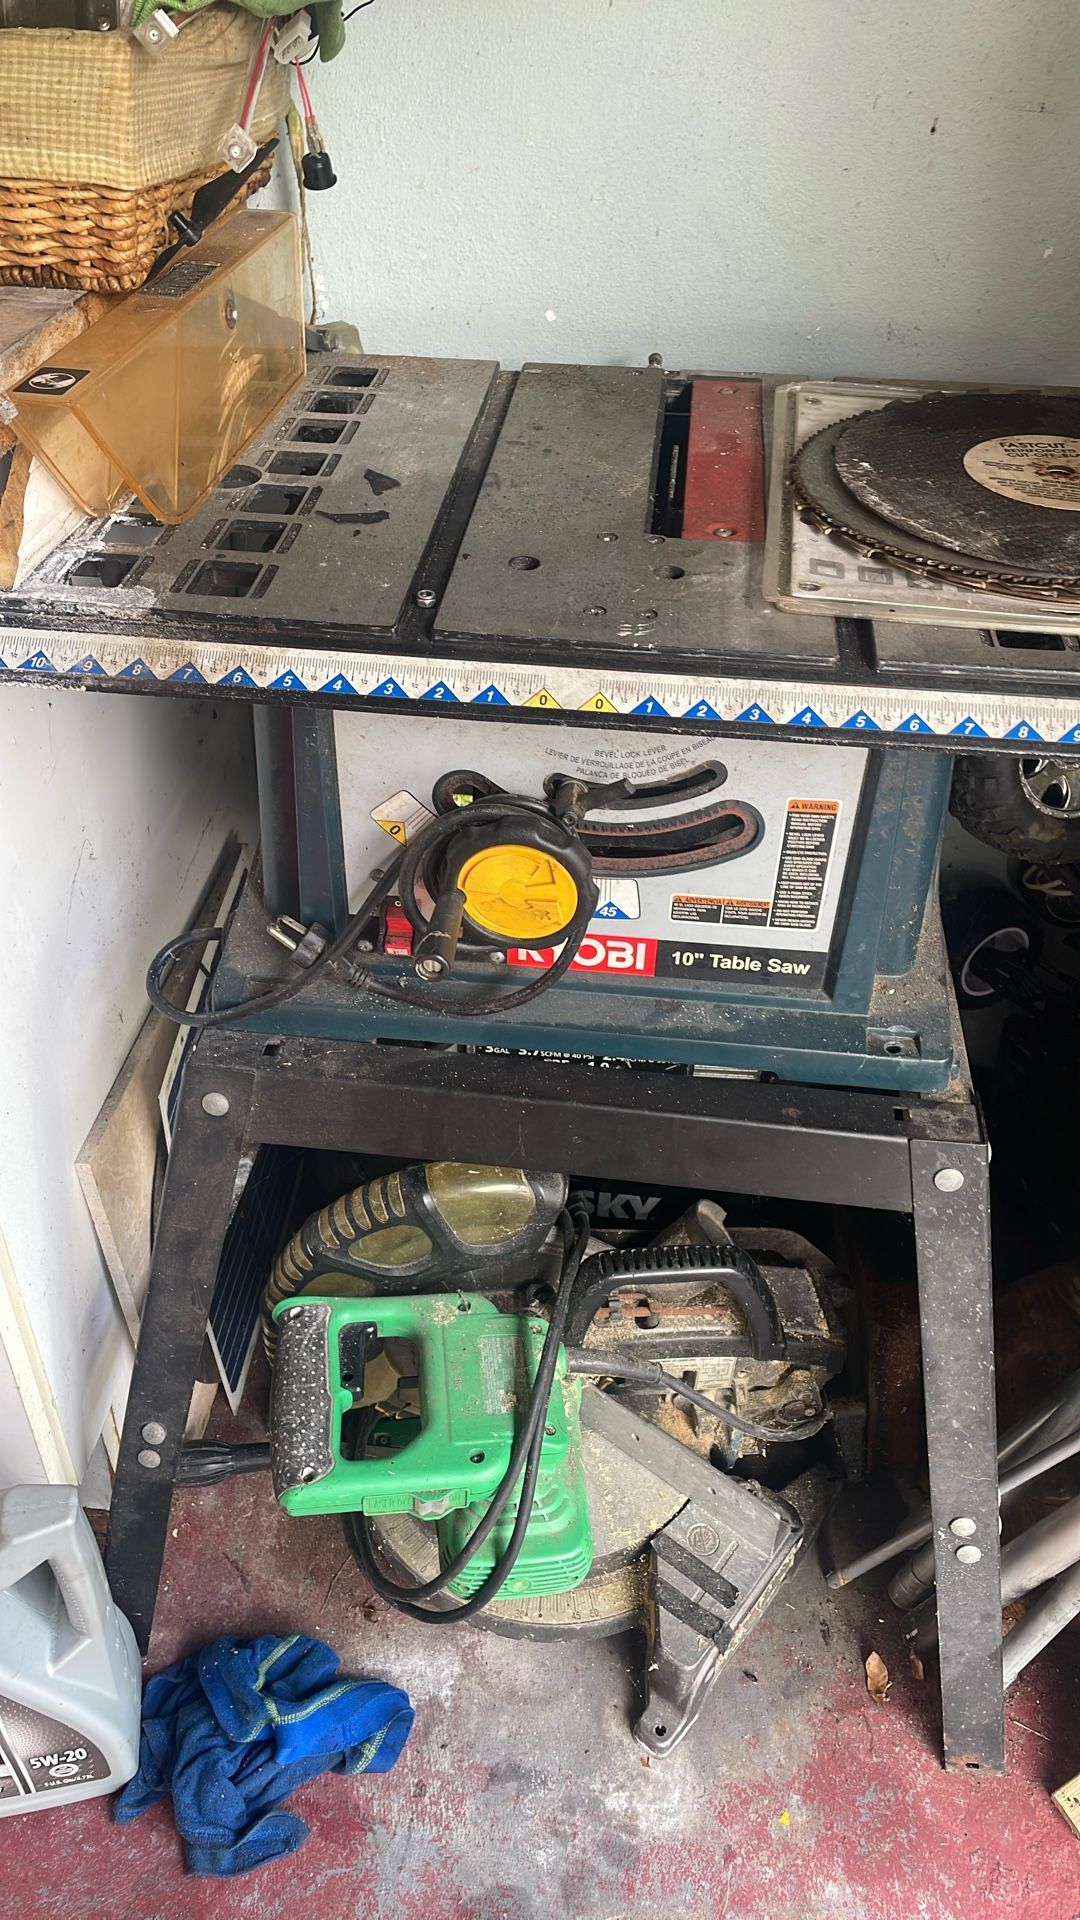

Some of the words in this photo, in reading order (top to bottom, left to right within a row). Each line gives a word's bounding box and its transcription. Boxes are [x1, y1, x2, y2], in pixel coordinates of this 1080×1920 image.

[30, 656, 46, 669] 10
[82, 660, 93, 672] 9
[132, 664, 143, 676] 8
[183, 668, 194, 680] 7
[232, 671, 243, 683] 6
[282, 675, 294, 687] 5
[332, 679, 343, 691] 4
[383, 683, 395, 695] 3
[433, 687, 445, 699] 2
[486, 690, 494, 703] 1
[539, 694, 548, 706] 0
[595, 698, 604, 710] 0
[645, 701, 654, 714] 1
[696, 705, 708, 717] 2
[749, 709, 760, 721] 3
[801, 712, 812, 724] 4
[855, 715, 867, 728] 5
[909, 719, 920, 731] 6
[964, 722, 976, 735] 7
[1018, 726, 1029, 738] 8
[545, 747, 569, 762] LEVIER
[570, 756, 580, 764] DE
[581, 757, 634, 770] VERROUILLAGE
[635, 760, 645, 769] DE
[646, 758, 657, 768] LA
[657, 751, 681, 765] COUPE
[681, 747, 692, 757] EN
[691, 736, 717, 753] BISEAU
[594, 749, 619, 759] BEVEL
[620, 750, 641, 759] LOCK
[643, 744, 667, 757] LEVER
[576, 766, 609, 780] PALANCA
[610, 771, 620, 780] DE
[622, 768, 657, 781] BLOQUEO
[658, 765, 669, 774] DE
[670, 758, 690, 771] BISEL
[801, 803, 837, 811] WARNING
[599, 906, 617, 917] 45
[672, 951, 704, 966] 10"
[710, 954, 760, 971] Table
[767, 958, 810, 975] Saw
[30, 1748, 87, 1769] 5W-20
